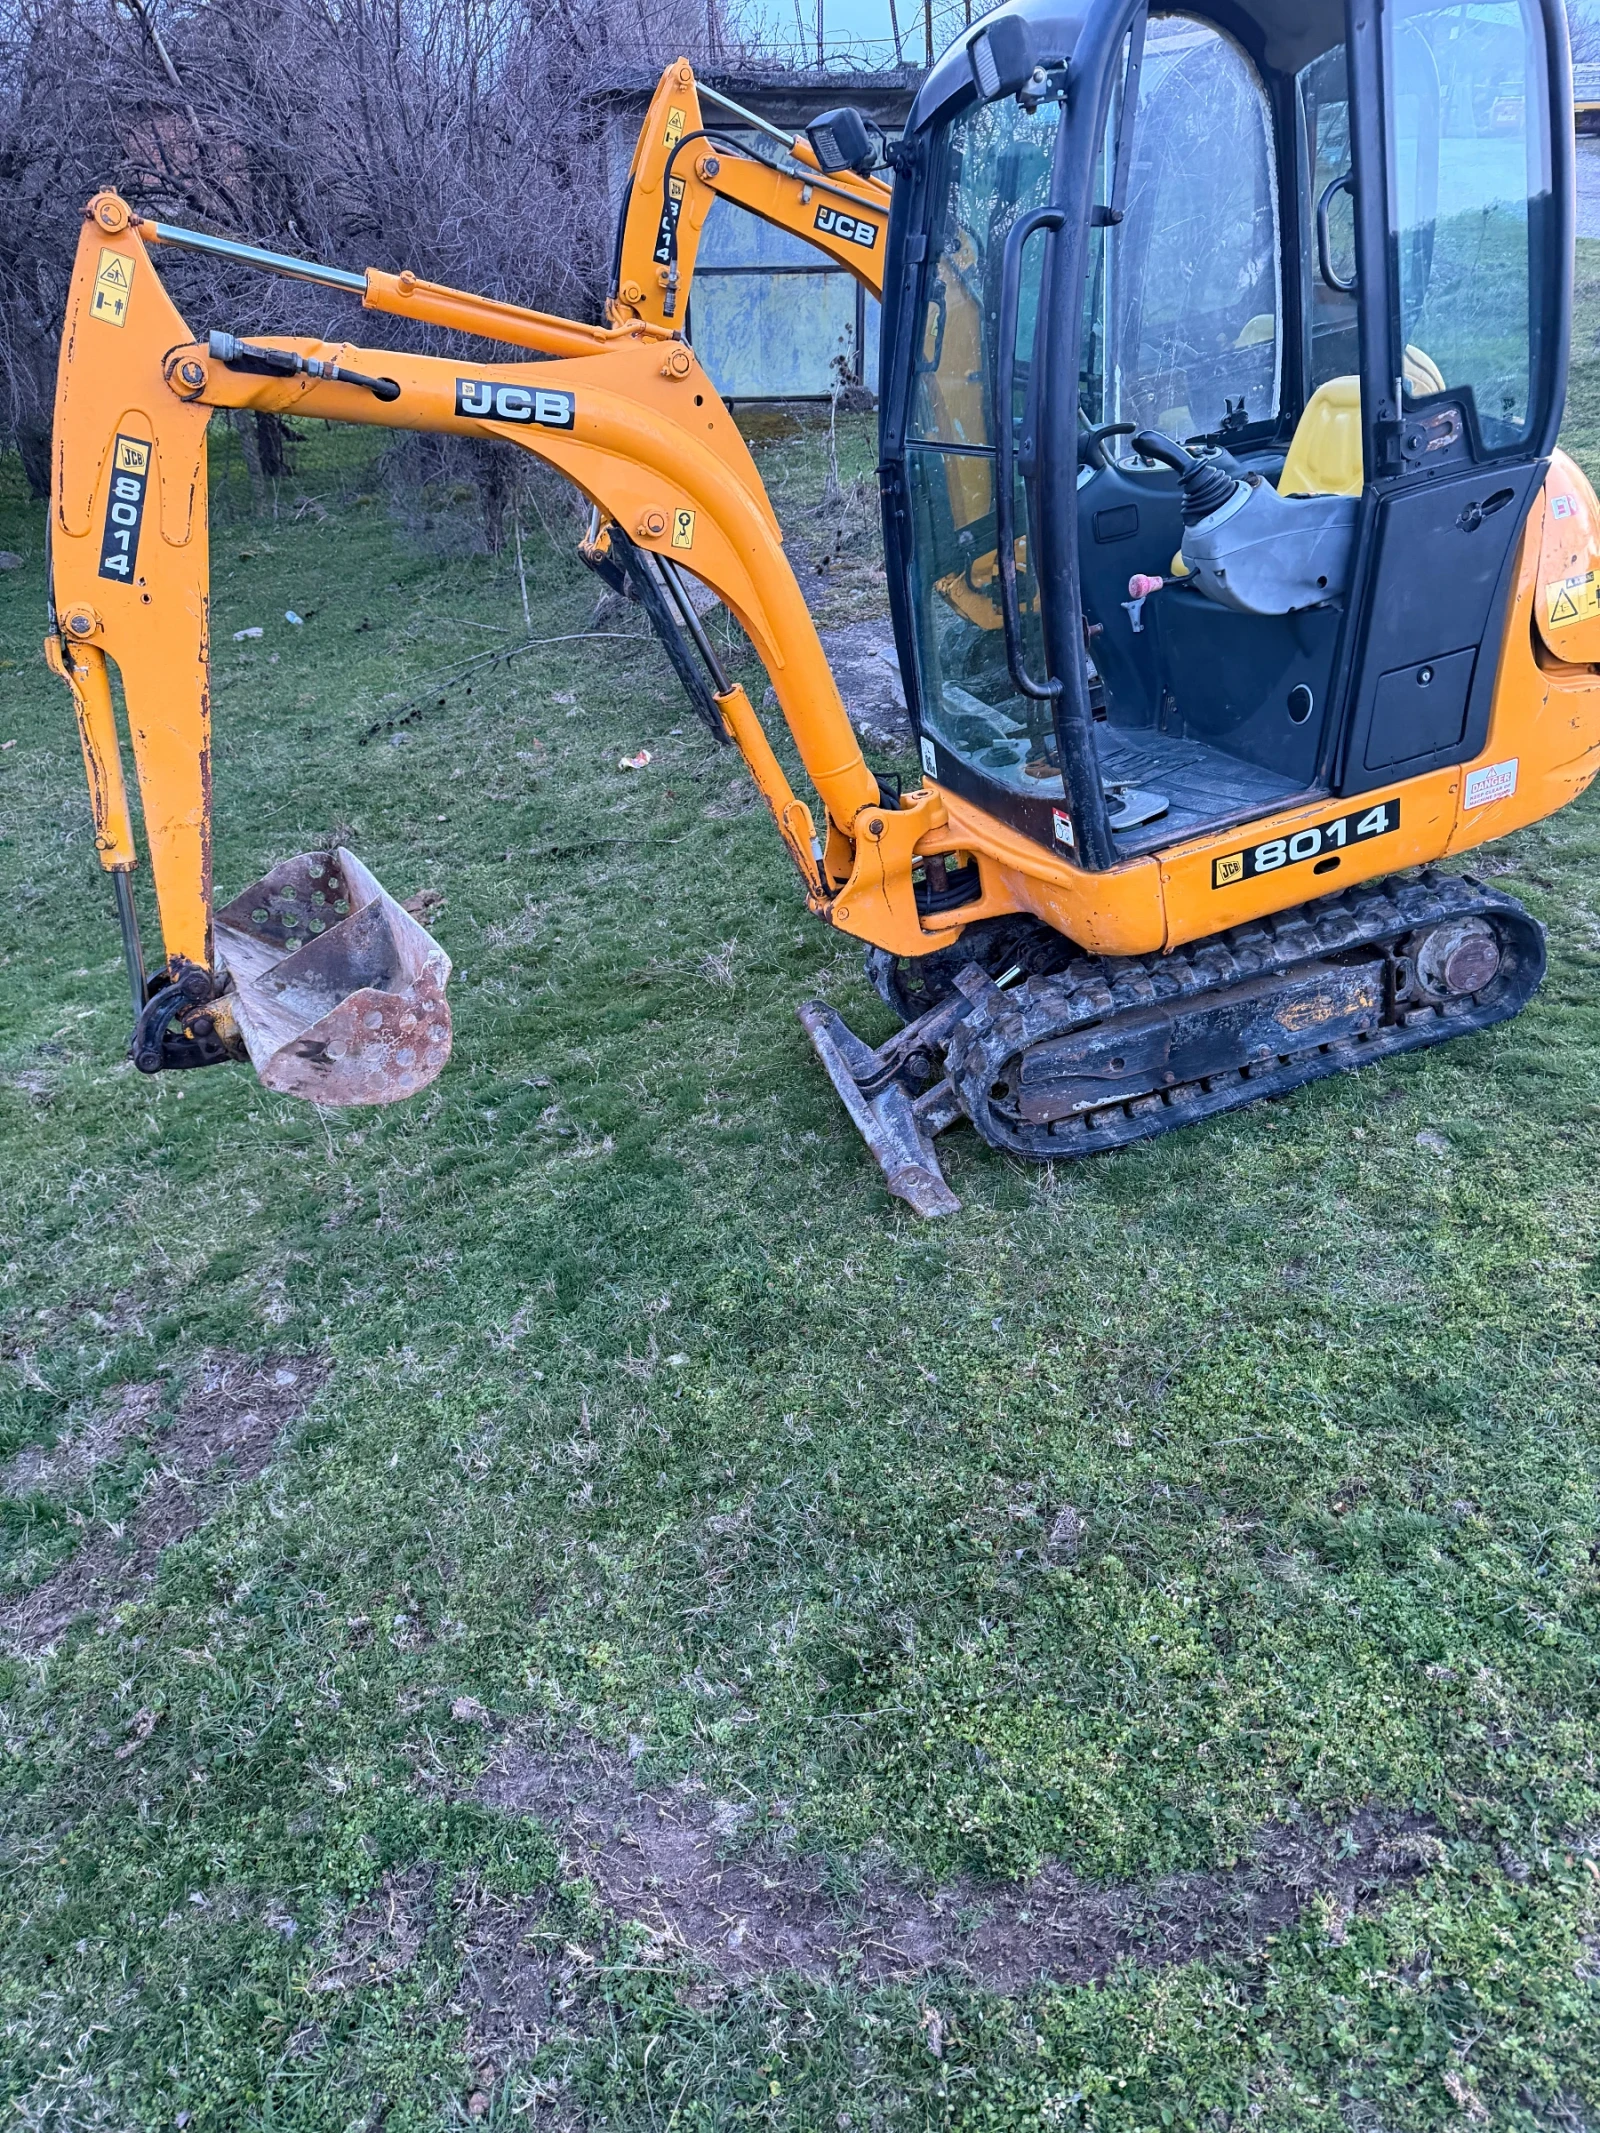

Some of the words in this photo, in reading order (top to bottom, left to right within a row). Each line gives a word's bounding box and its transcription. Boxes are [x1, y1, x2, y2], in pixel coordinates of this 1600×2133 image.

[818, 211, 875, 246] JCB
[462, 384, 570, 424] JCB
[124, 447, 144, 466] JCB
[105, 476, 141, 576] 8014
[1472, 773, 1511, 793] DANGER
[1222, 862, 1240, 879] JCB
[1254, 804, 1389, 873] 8014
